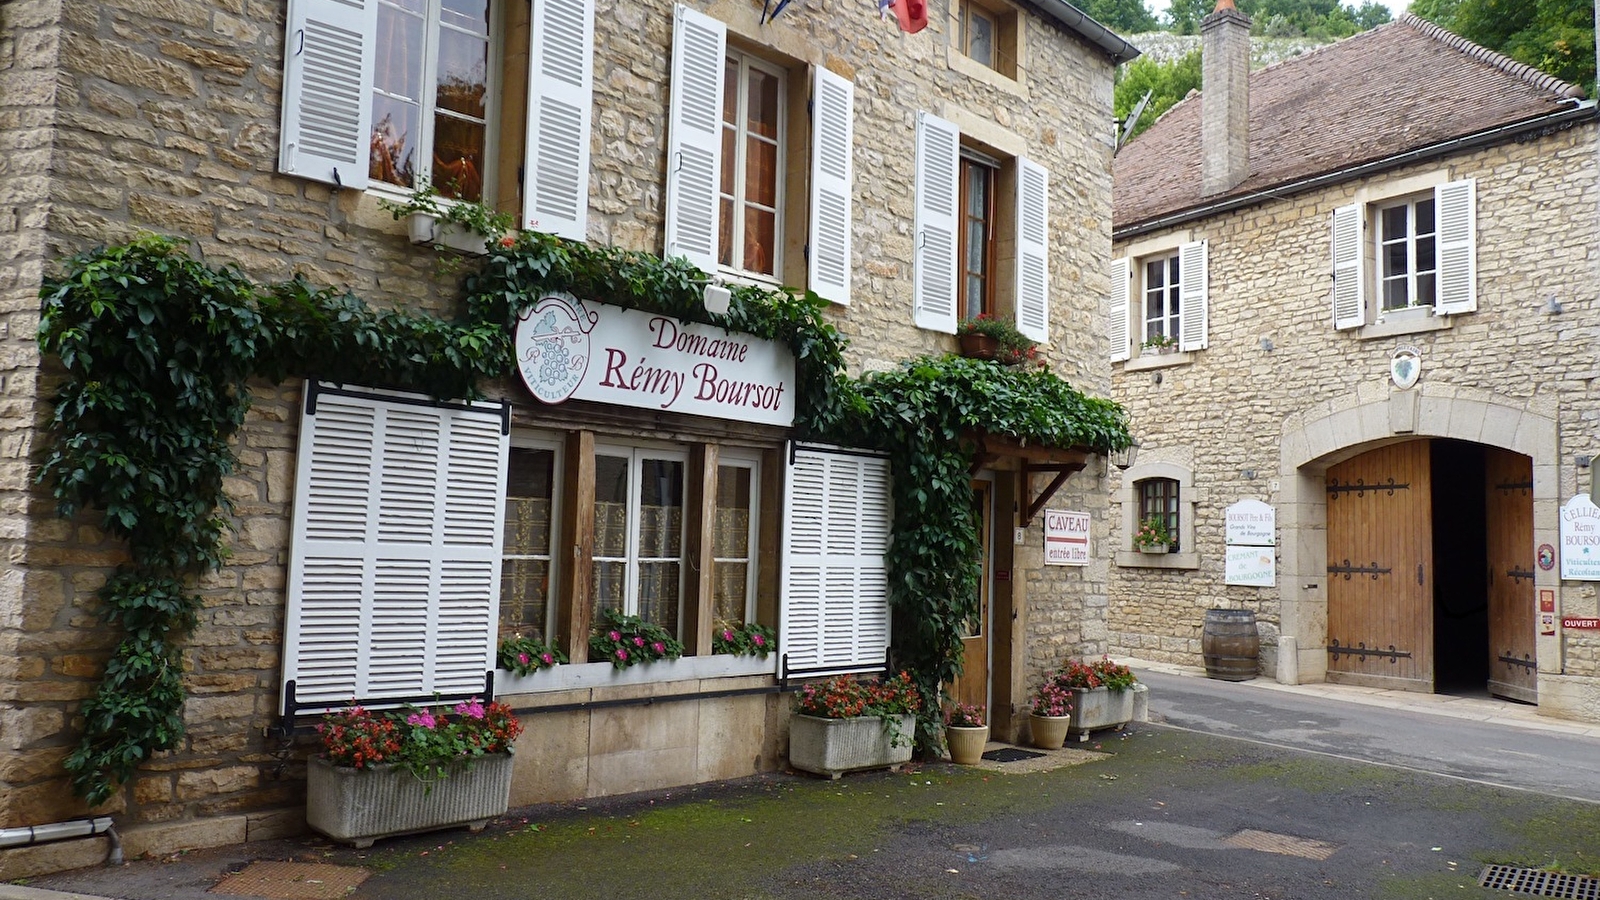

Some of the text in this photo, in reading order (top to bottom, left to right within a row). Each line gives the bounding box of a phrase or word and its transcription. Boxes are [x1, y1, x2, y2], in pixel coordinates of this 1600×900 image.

[649, 317, 748, 363] Domaine
[523, 367, 580, 399] VITICULTEUR
[599, 347, 784, 411] Rémy Boursot
[1563, 507, 1600, 522] CELLIE
[1048, 515, 1089, 532] CAVEAU
[1574, 522, 1596, 535] Rémy
[1247, 530, 1271, 538] Bourgogne
[1049, 547, 1087, 560] entrée libre
[1228, 571, 1272, 582] BOURGOGNE
